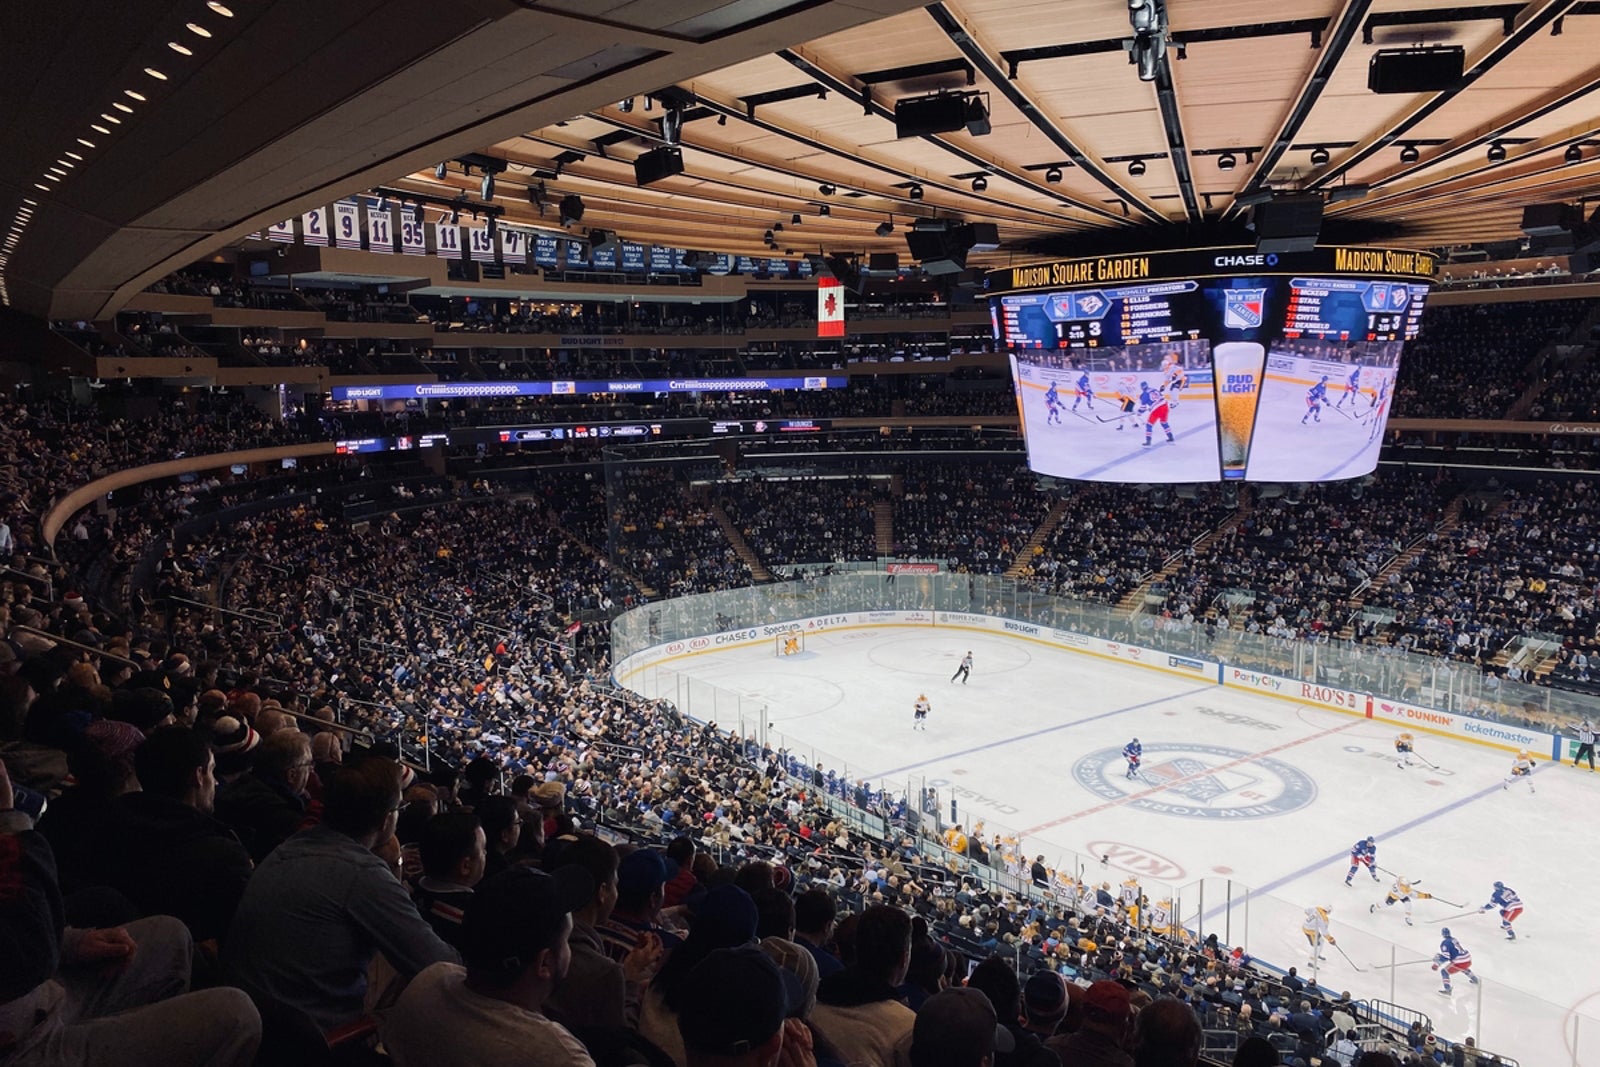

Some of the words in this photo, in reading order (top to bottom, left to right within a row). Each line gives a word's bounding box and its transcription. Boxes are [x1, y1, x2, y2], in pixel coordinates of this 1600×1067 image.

[309, 211, 321, 234] 2
[342, 216, 352, 238] 9
[373, 220, 388, 243] 11
[403, 223, 423, 245] 35
[440, 227, 457, 248] 11
[1214, 255, 1265, 267] CHASE
[1335, 248, 1383, 271] MADISON
[1385, 250, 1414, 274] SQUARE
[1012, 267, 1050, 288] MADISON
[1053, 262, 1094, 285] SQUARE
[1098, 257, 1149, 280] GARDEN
[1129, 295, 1150, 304] ELLIS
[1232, 303, 1259, 325] RANGERS
[1368, 314, 1376, 329] 1
[1088, 321, 1101, 336] 3
[1392, 315, 1401, 330] 3
[1055, 323, 1063, 338] 1
[1227, 374, 1253, 384] BUD
[362, 388, 381, 397] LIGHT
[1222, 384, 1256, 393] LIGHT
[590, 427, 597, 437] 3
[817, 616, 848, 627] DELTA
[1005, 622, 1019, 631] BUD
[1020, 625, 1038, 634] LIGHT
[763, 623, 800, 636] Spectrum
[715, 631, 748, 645] CHASE
[1301, 682, 1345, 706] RAO'S
[1407, 708, 1454, 726] DUNKIN'
[1464, 721, 1534, 745] ticketmaster
[1079, 757, 1122, 799] RANGERS
[1136, 799, 1208, 817] YORK
[1219, 804, 1278, 819] NEW
[1105, 844, 1174, 876] KIA
